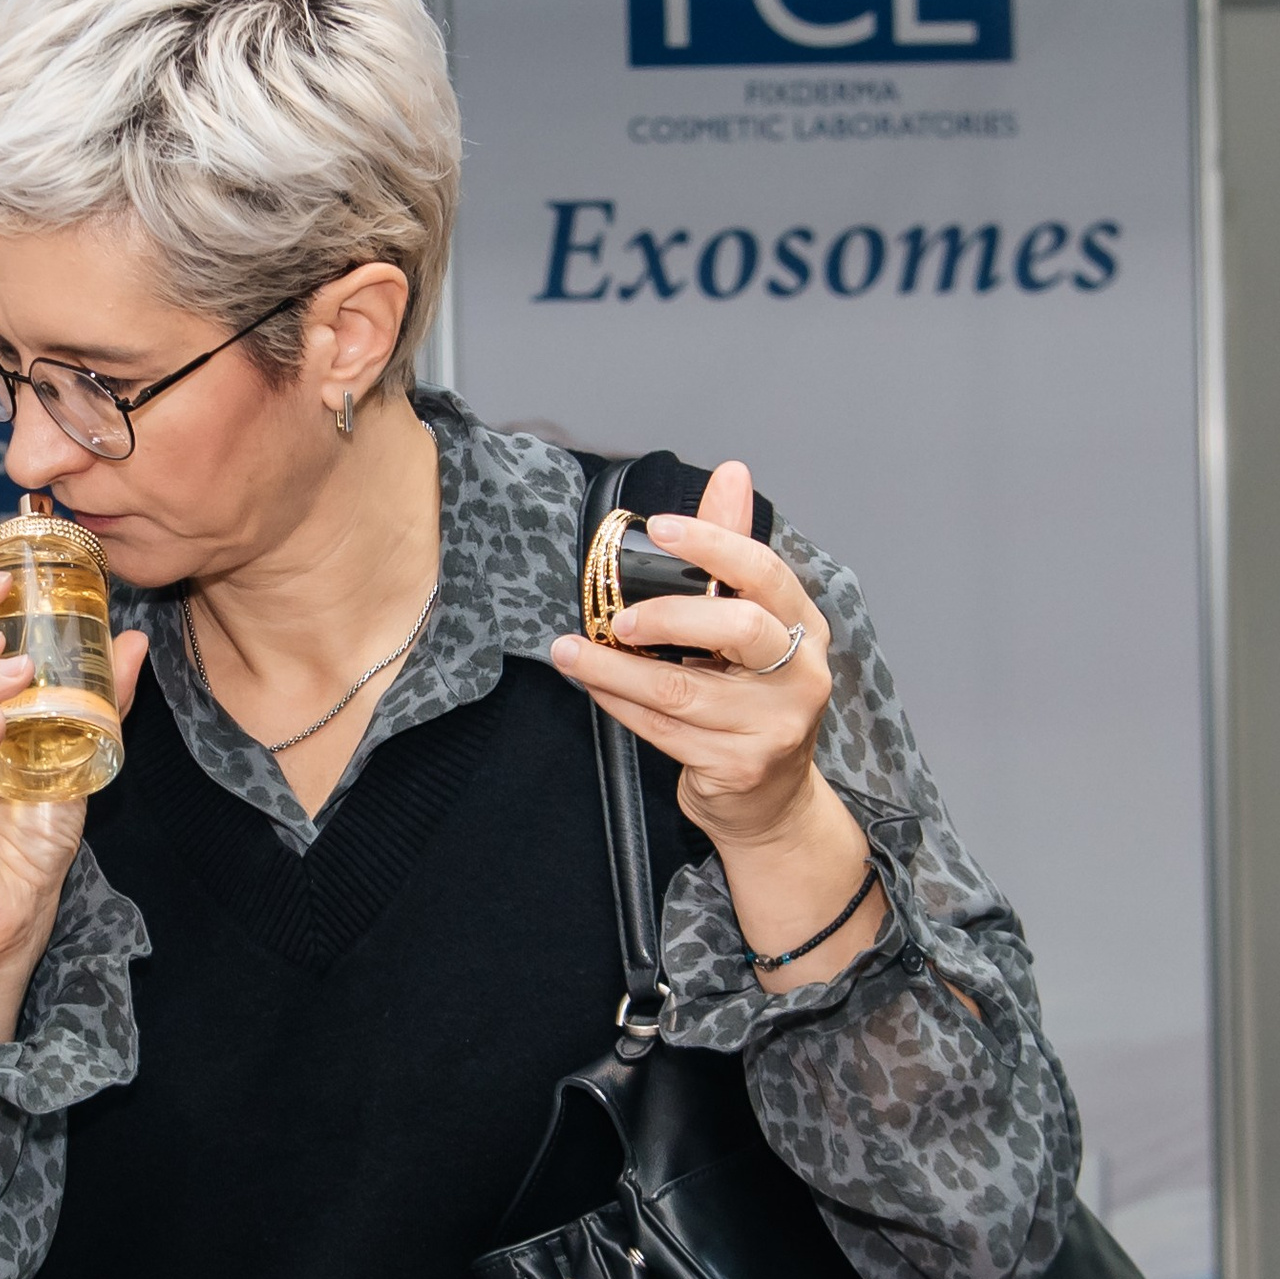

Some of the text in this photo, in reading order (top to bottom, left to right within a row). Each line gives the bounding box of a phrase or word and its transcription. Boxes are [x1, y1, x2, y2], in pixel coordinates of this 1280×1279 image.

[628, 111, 1020, 144] COSMETIC LABORATORIES
[532, 199, 1122, 303] Exosomes
